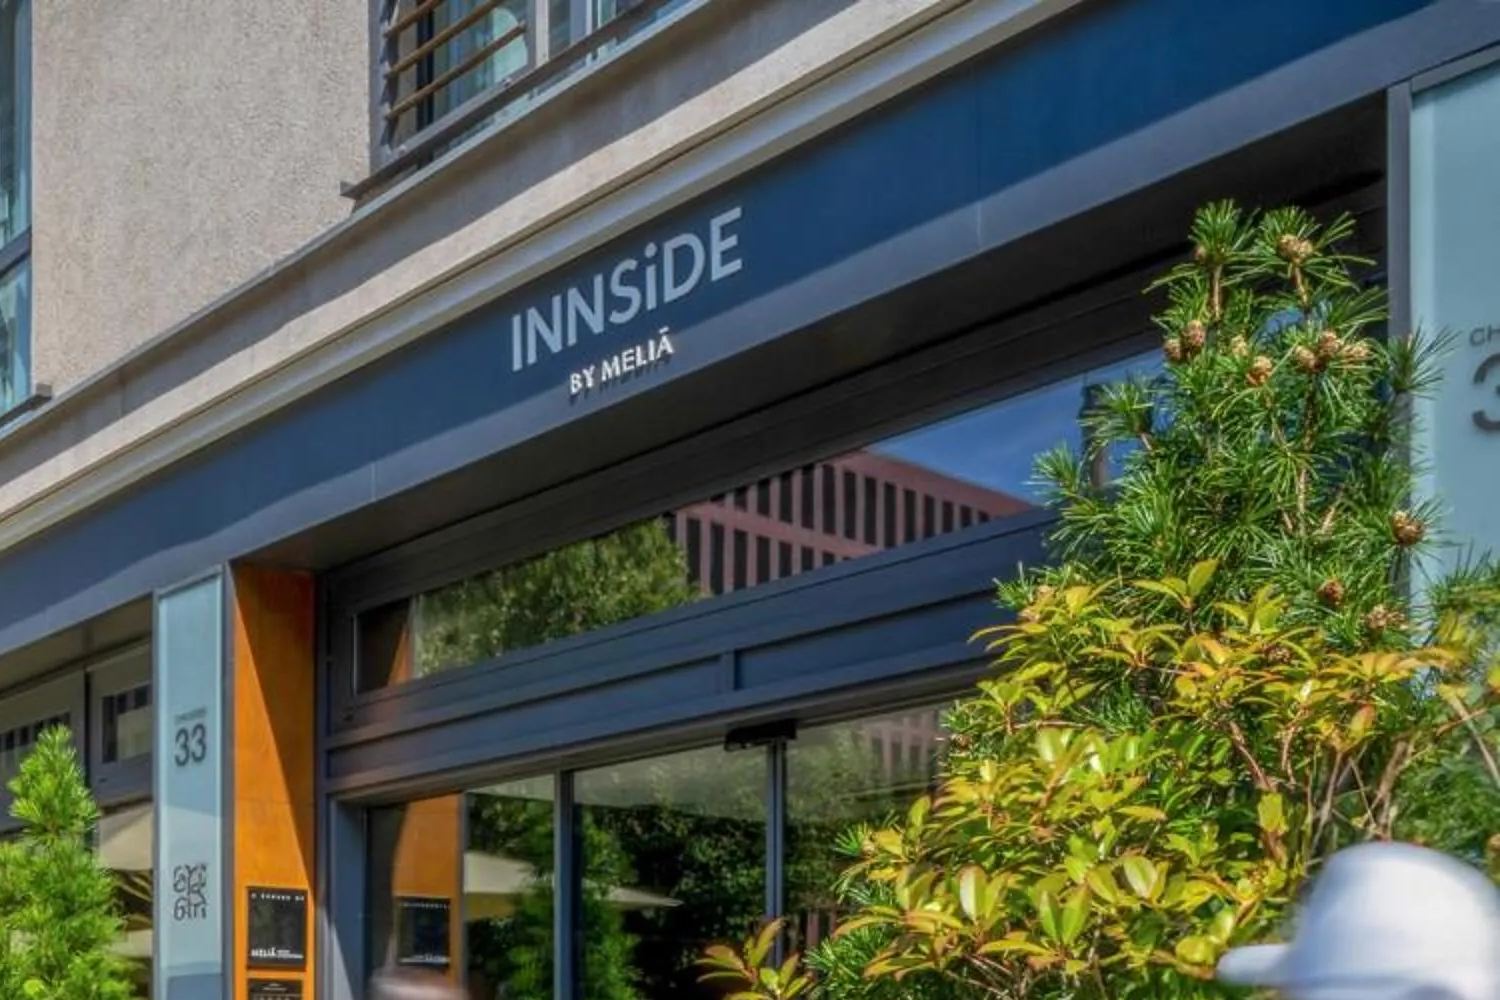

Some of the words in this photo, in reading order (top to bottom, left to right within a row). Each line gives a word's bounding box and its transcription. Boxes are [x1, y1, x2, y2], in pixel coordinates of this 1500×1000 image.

[512, 207, 742, 372] INNSiDE
[570, 365, 595, 394] BY
[175, 723, 206, 767] 33
